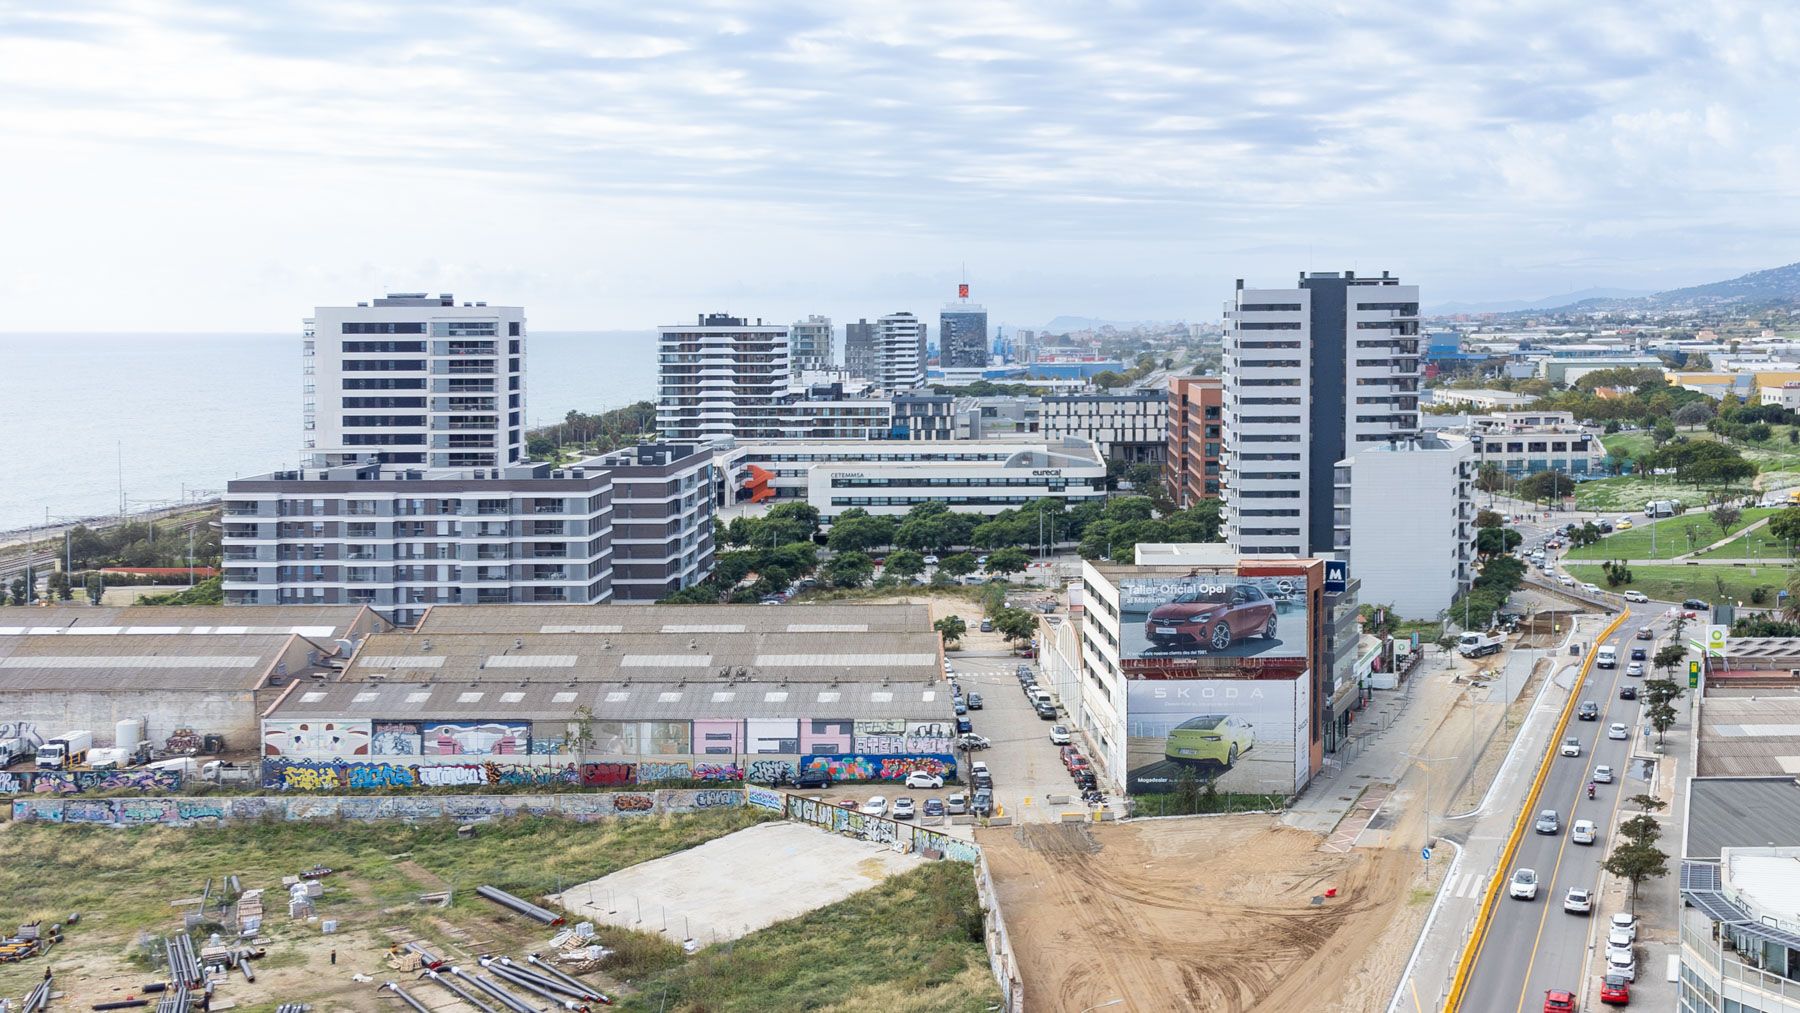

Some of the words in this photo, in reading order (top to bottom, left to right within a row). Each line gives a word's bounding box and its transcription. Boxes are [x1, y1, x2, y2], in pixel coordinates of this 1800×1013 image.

[1032, 469, 1061, 478] eurecat
[1329, 568, 1342, 580] M
[1128, 584, 1157, 595] Taller
[1160, 584, 1196, 594] Oficial
[1199, 584, 1227, 596] Opel
